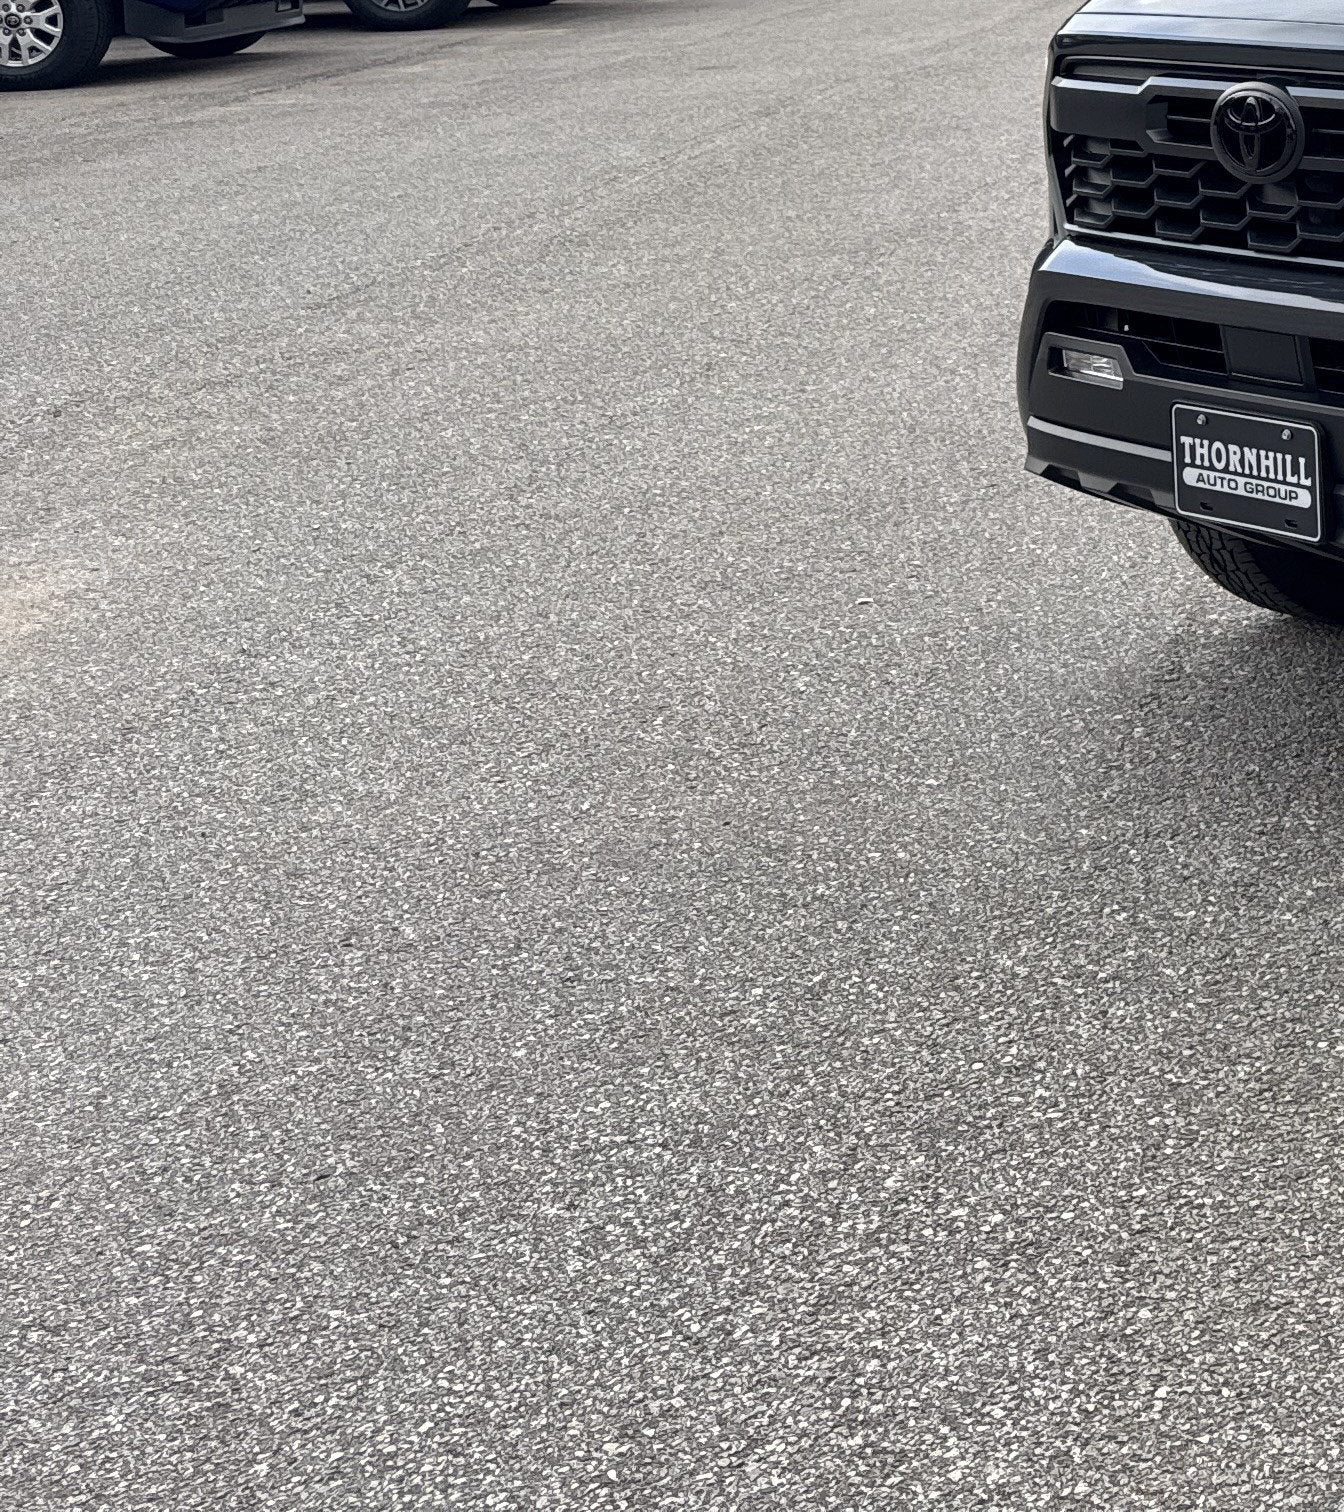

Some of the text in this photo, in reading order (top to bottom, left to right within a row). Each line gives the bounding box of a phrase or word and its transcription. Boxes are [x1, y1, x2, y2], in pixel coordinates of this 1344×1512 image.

[1180, 435, 1312, 486] THORNHILL
[1196, 472, 1299, 502] AUTO GROUP
